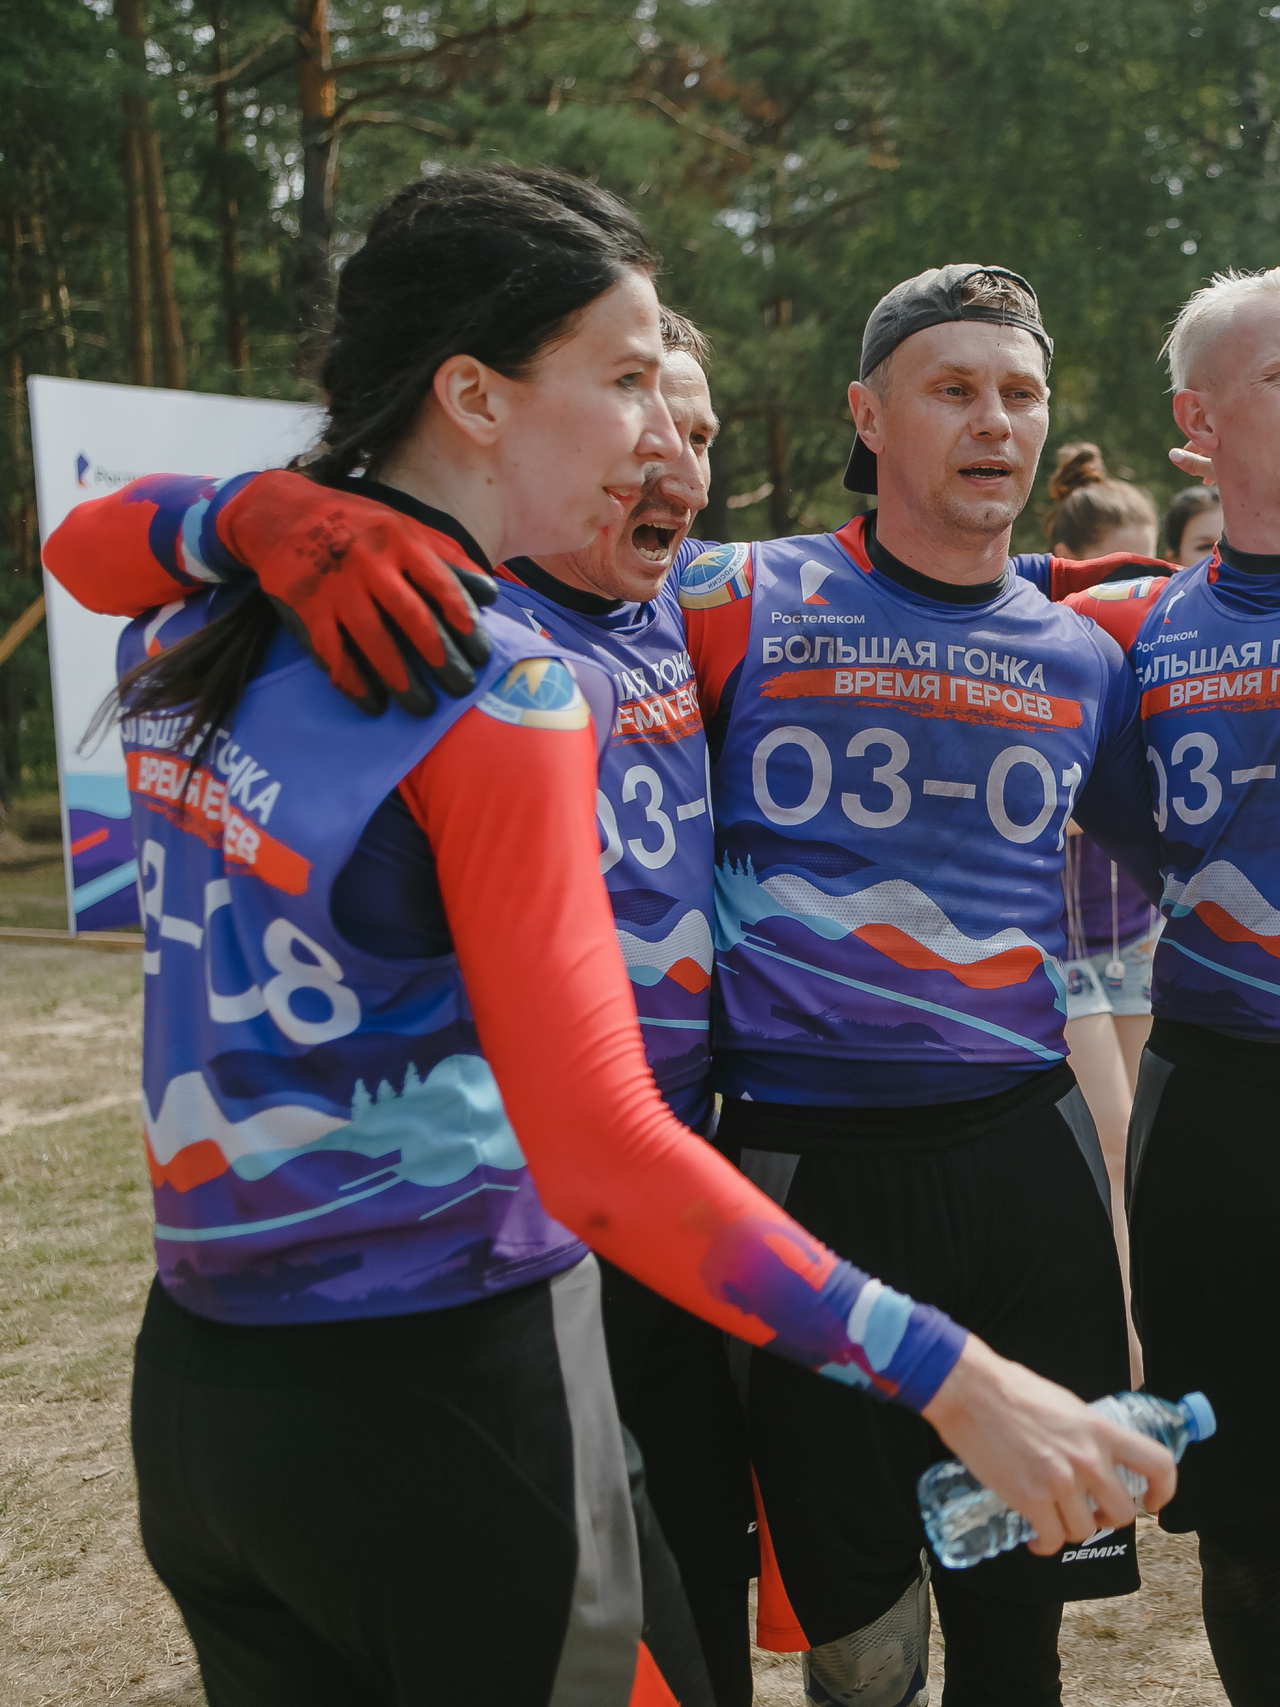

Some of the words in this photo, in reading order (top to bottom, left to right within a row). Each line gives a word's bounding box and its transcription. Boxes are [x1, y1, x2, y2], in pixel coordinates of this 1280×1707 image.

[707, 566, 734, 589] РОССИИ
[771, 611, 866, 625] Ростелеком
[762, 635, 937, 668] БОЛЬШАЯ
[947, 644, 1047, 692] ГОНКА
[834, 671, 941, 700] ВРЕМЯ
[950, 677, 1053, 721] ГЕРОЕВ
[1169, 671, 1263, 708] ВРЕМЯ
[751, 725, 1082, 853] 03-01
[1061, 1543, 1128, 1563] DEMIX
